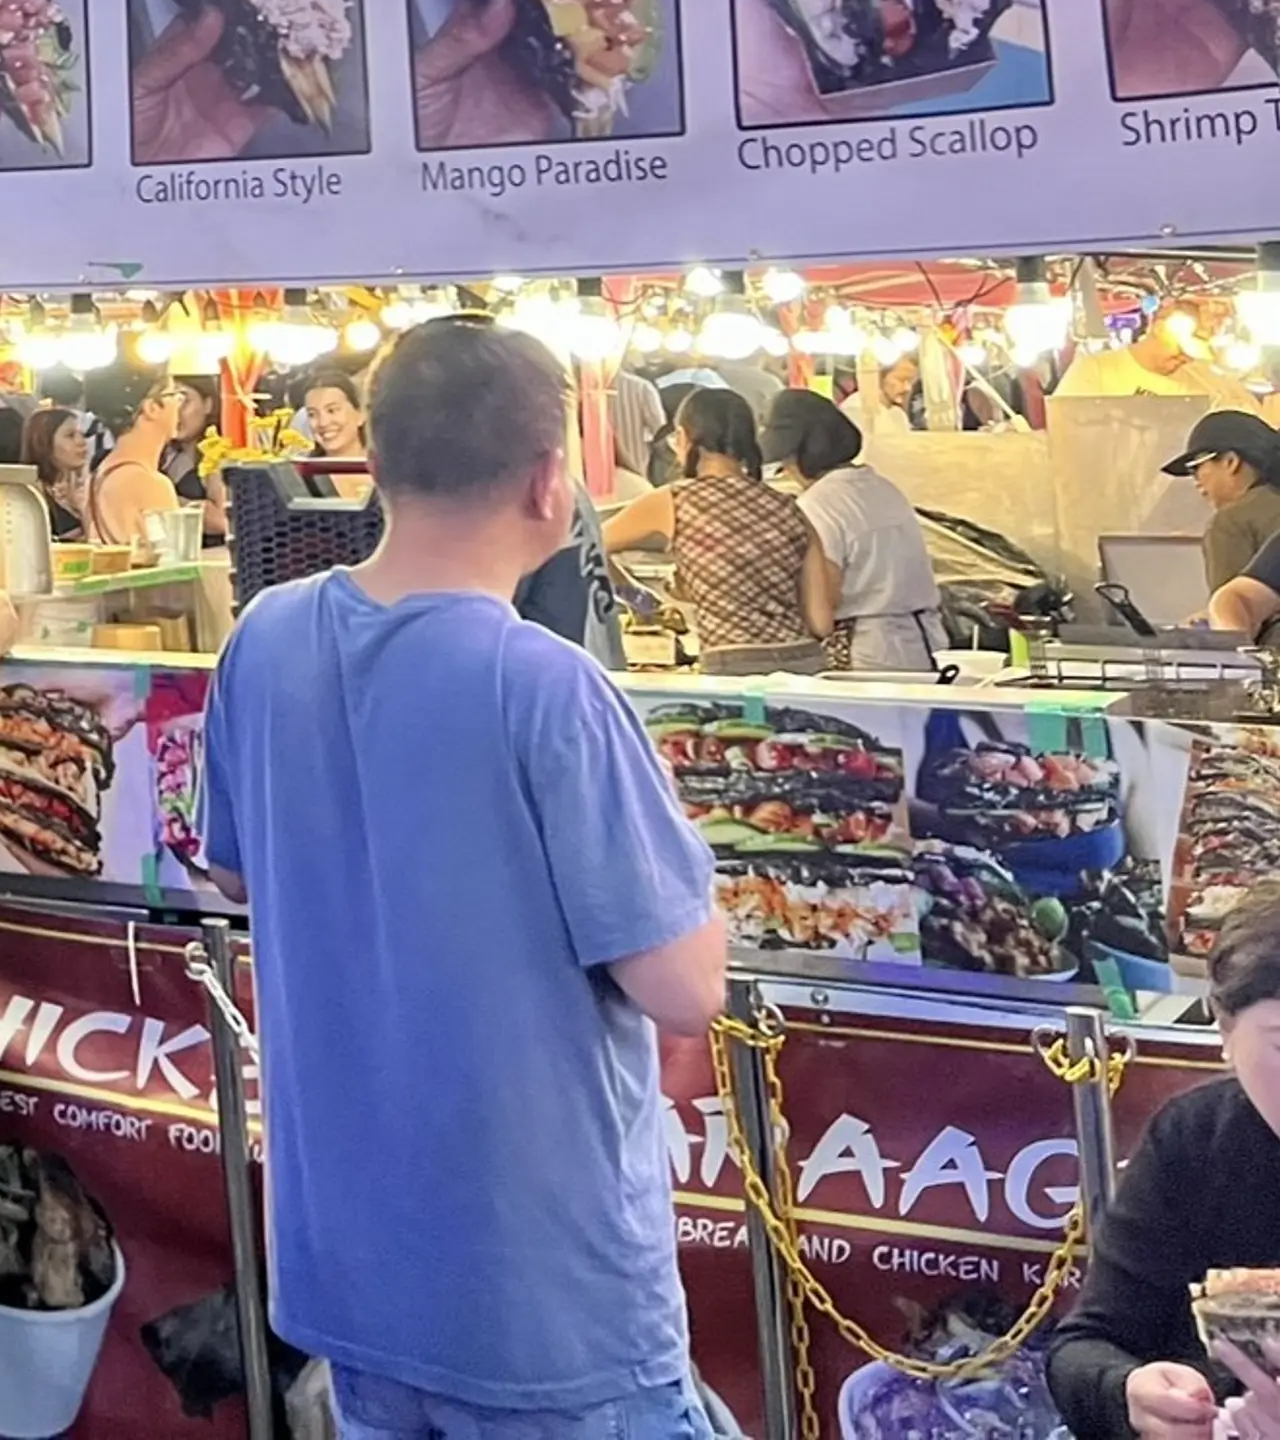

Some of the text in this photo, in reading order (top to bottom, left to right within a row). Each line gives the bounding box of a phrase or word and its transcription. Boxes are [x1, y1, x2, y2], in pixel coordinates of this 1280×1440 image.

[737, 120, 1039, 173] Chopped Scallop
[1121, 107, 1258, 147] Shrimp
[137, 167, 343, 204] California Style
[421, 148, 669, 200] Mango Paradise
[52, 1103, 153, 1140] COMFORT
[167, 1122, 222, 1155] FOO
[676, 1215, 750, 1249] BREA
[797, 1237, 851, 1265] AND
[872, 1245, 1001, 1283] CHICKEN
